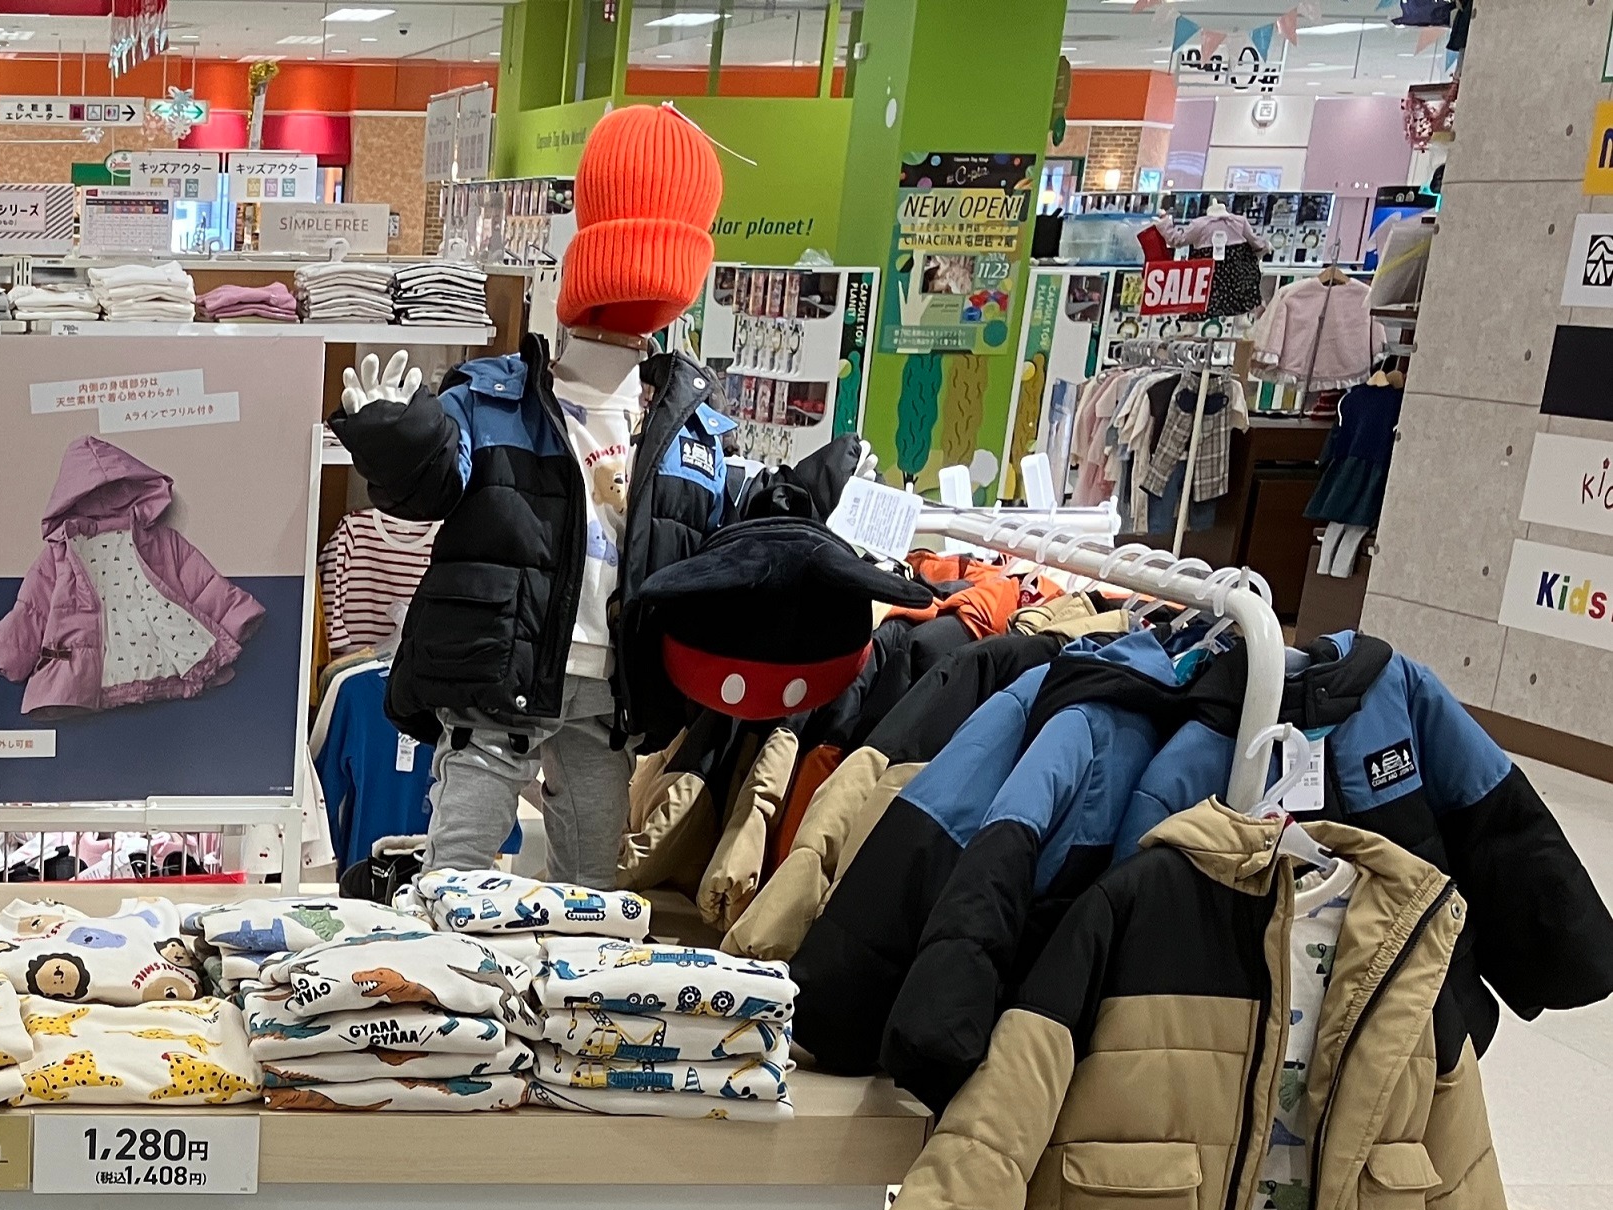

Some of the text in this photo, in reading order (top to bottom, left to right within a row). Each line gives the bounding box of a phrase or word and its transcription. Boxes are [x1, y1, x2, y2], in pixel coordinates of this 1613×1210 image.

[5, 112, 64, 121] エレベーター
[139, 163, 212, 174] キッズアウター
[236, 164, 309, 175] キッズアウター
[903, 195, 1022, 219] NEW OPEN!
[336, 218, 368, 231] FREE
[977, 263, 1011, 279] 11.23
[1145, 267, 1211, 307] SALE
[848, 282, 859, 322] PLANET
[855, 282, 869, 347] CAPSULE TOY
[124, 405, 214, 422] Aラインでフリル付き
[349, 1020, 399, 1038] GYAAA
[369, 1030, 419, 1044] GYAAA
[84, 1128, 209, 1161] 1,280円
